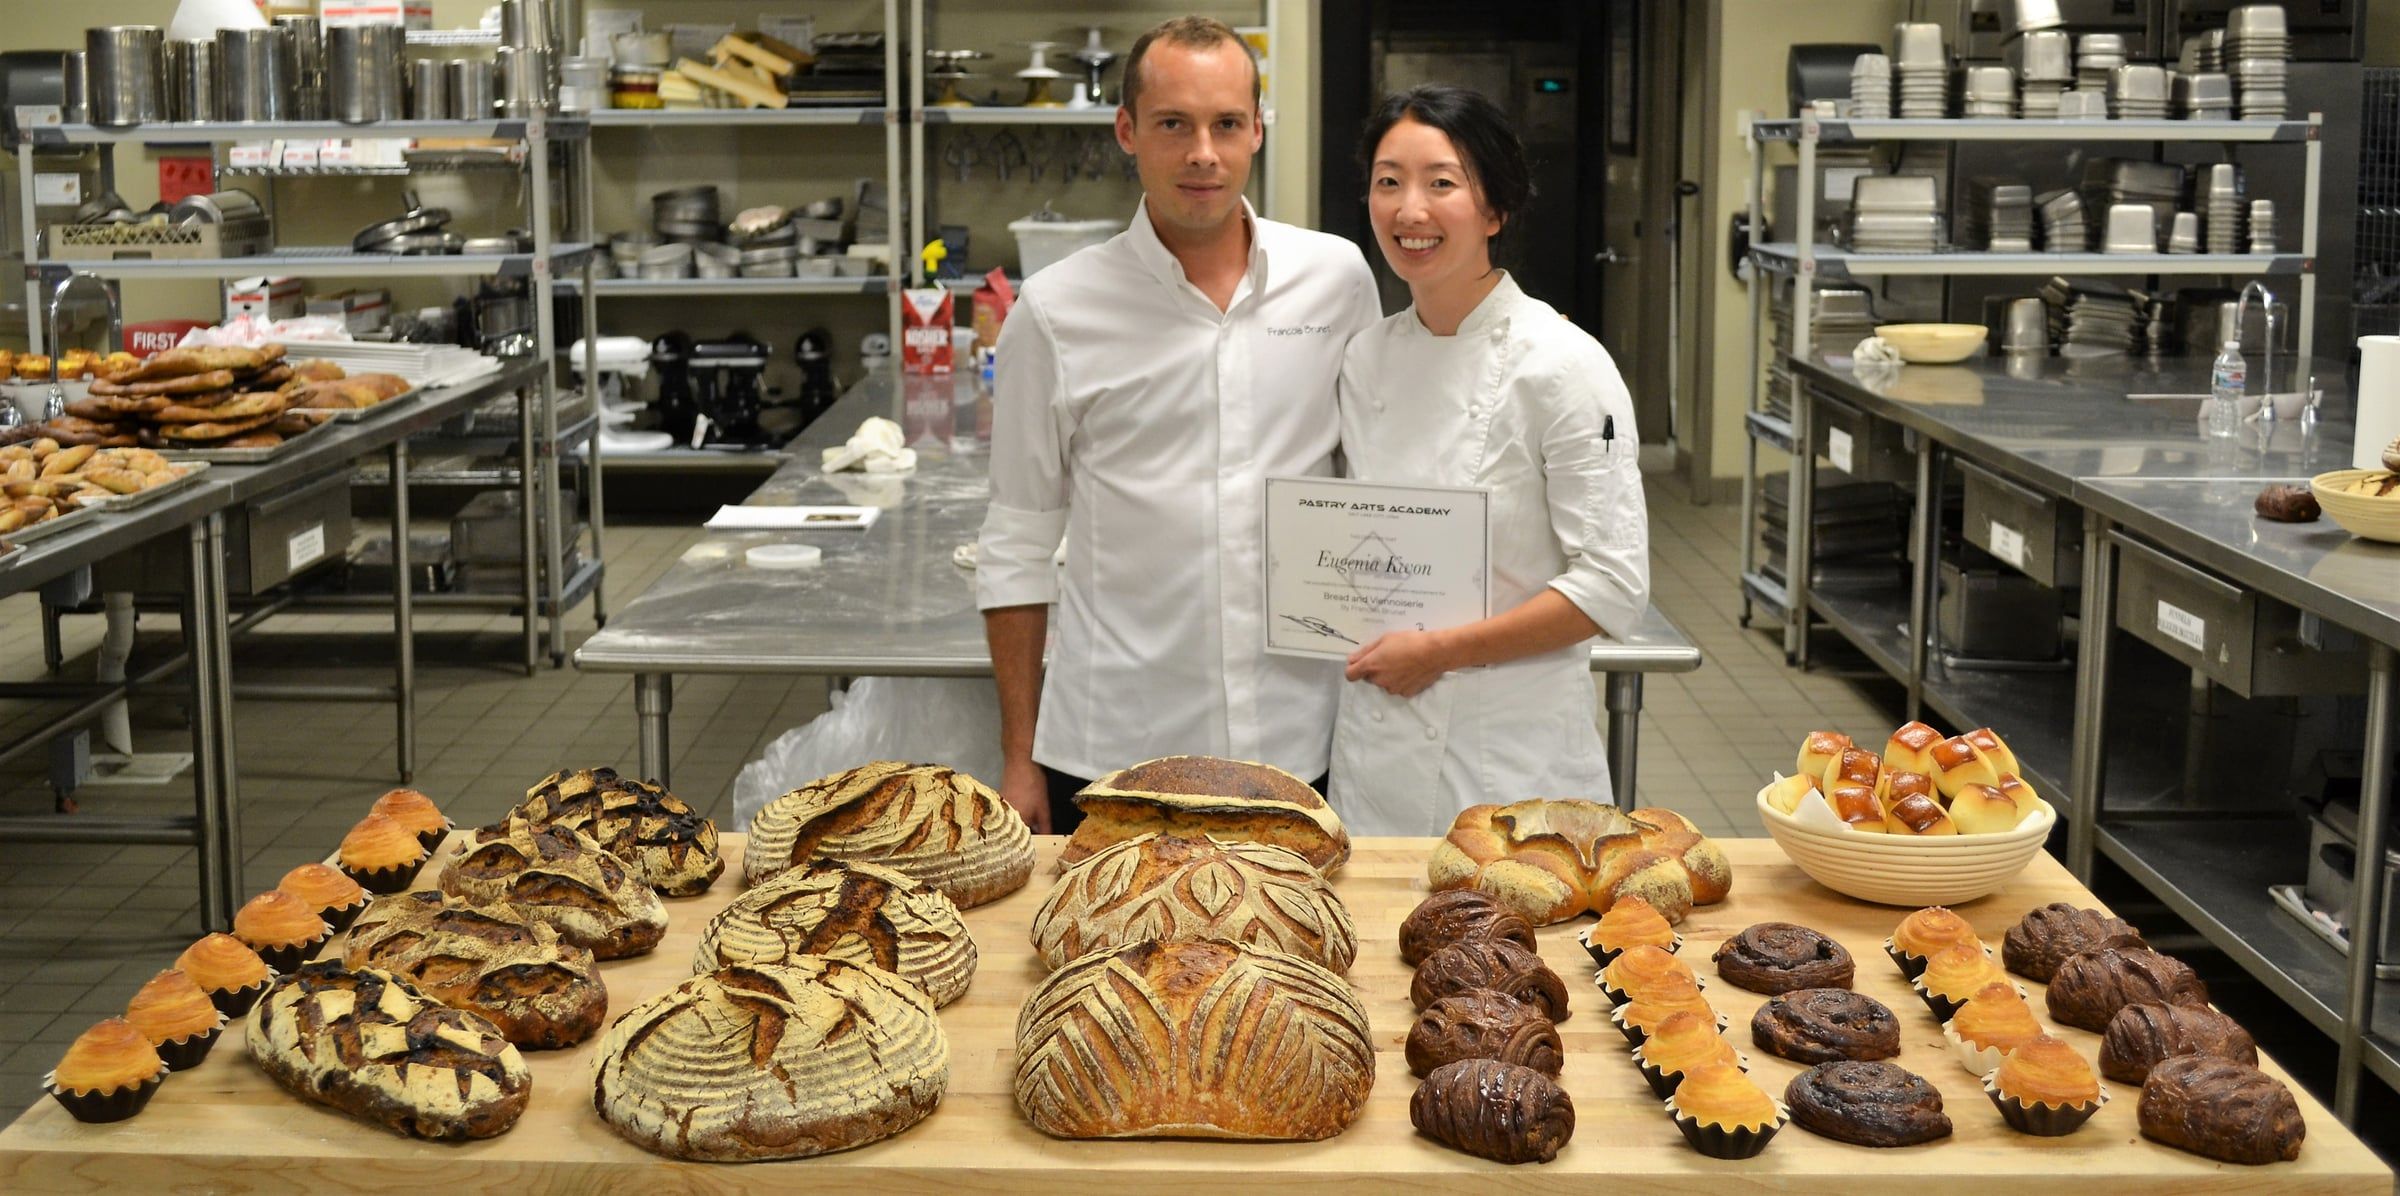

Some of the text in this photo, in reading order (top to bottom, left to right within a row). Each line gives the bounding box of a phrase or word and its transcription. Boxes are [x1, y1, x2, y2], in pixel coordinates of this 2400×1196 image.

[133, 331, 177, 351] FIRST
[905, 329, 948, 347] KOSHER
[1298, 499, 1451, 516] PASTRY ARTS ACADEMY
[1317, 550, 1432, 576] Eugenia Kwon
[1323, 592, 1424, 608] Bread and Viennoiserie
